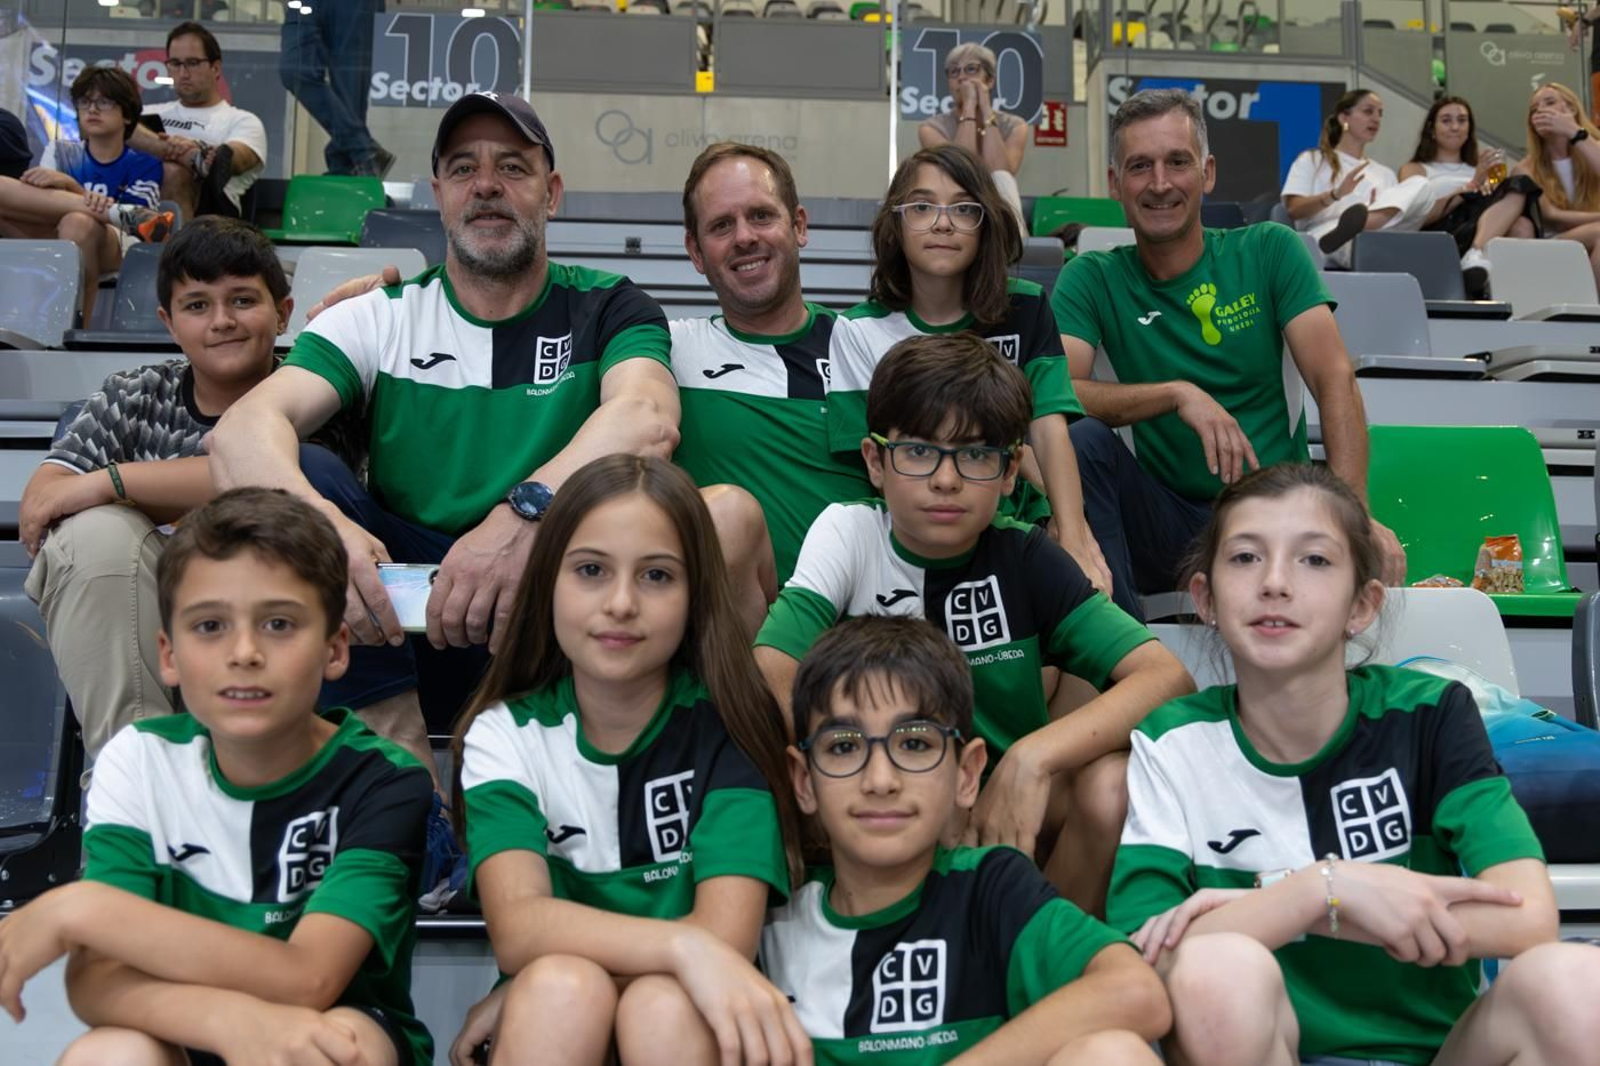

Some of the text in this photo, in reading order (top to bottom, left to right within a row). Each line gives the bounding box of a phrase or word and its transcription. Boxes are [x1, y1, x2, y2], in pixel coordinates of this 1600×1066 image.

[370, 71, 481, 101] Sector
[1107, 76, 1260, 120] Stor
[900, 86, 1006, 114] Secr
[1214, 292, 1256, 317] GALEY
[543, 345, 554, 357] C
[542, 365, 553, 377] D
[953, 589, 989, 610] C V
[956, 619, 998, 641] D G
[654, 792, 671, 812] C
[1341, 784, 1388, 815] C V
[292, 827, 307, 848] C
[661, 828, 679, 848] D
[1349, 820, 1403, 852] D G
[882, 954, 933, 978] C V
[880, 993, 933, 1018] D G
